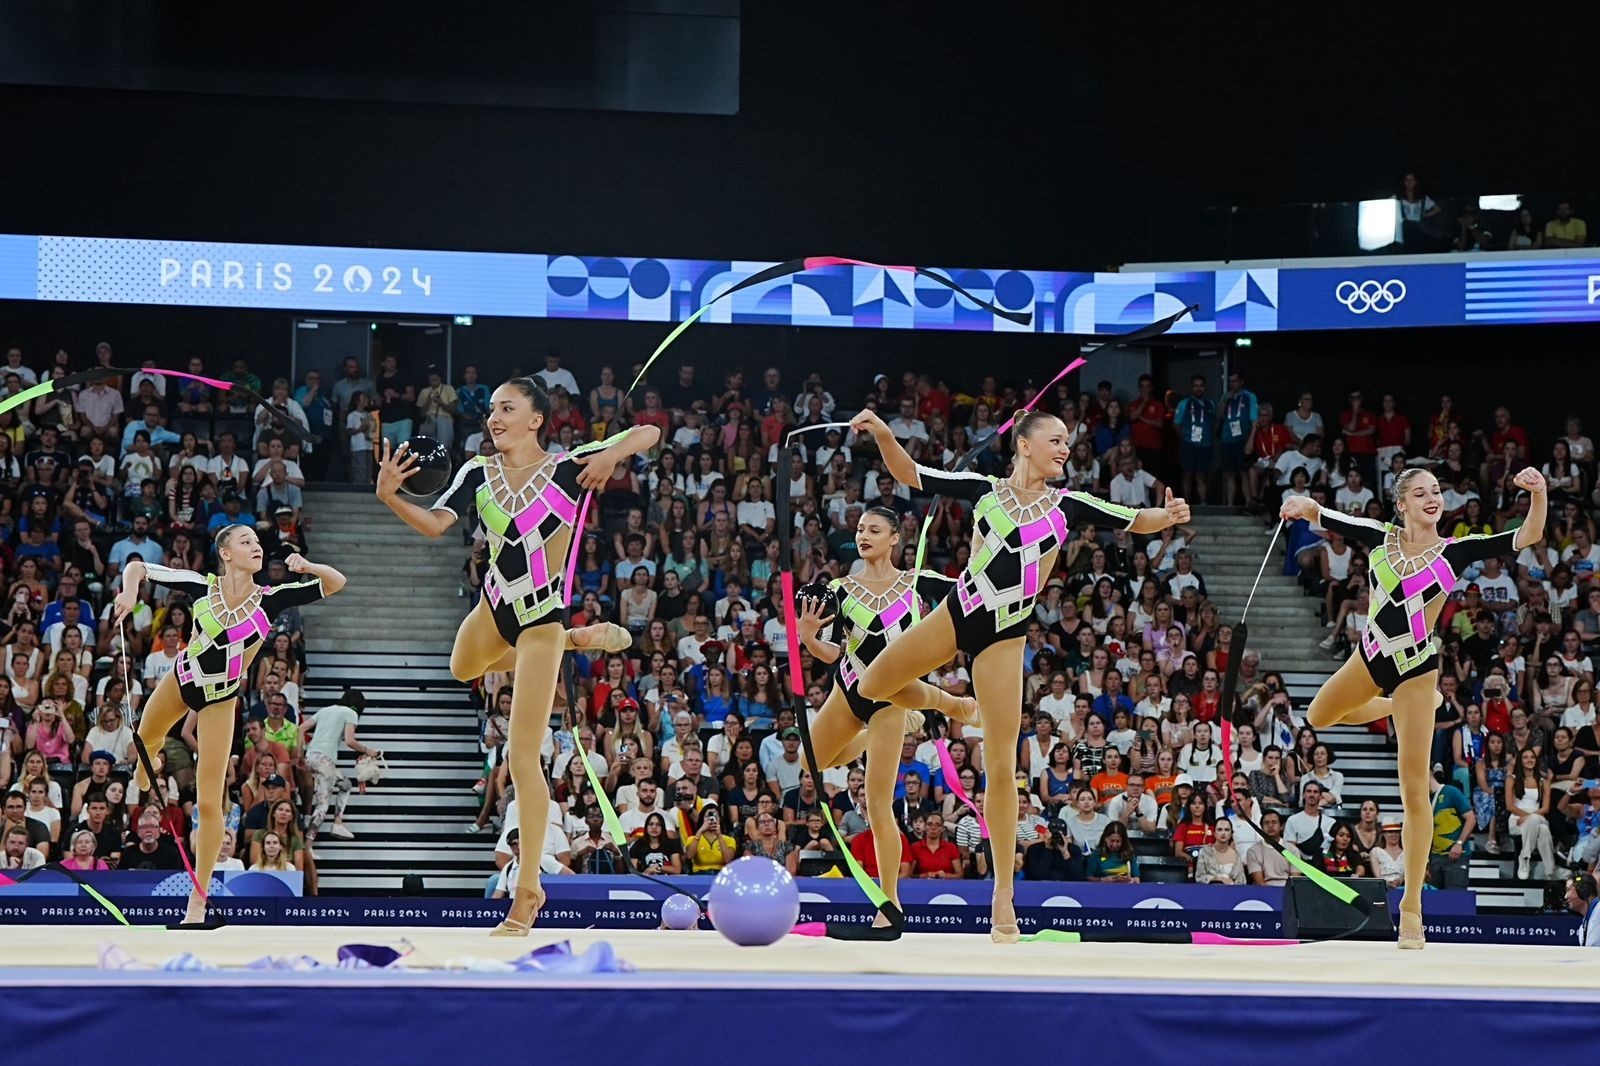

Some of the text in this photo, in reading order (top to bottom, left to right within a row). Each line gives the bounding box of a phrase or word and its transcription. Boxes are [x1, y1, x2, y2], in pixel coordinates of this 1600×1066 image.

[313, 263, 432, 296] 2024
[78, 908, 107, 916] 2024
[237, 908, 266, 916] 2024
[320, 909, 350, 917] 2024
[399, 909, 428, 918] 2024
[476, 910, 505, 918] 2024
[553, 911, 581, 919] 2024
[629, 911, 657, 919] 2024
[800, 914, 813, 922] 24
[860, 915, 874, 923] 20
[934, 916, 962, 924] 2024
[1016, 917, 1037, 925] 024
[1086, 919, 1114, 927] 2024
[1160, 920, 1188, 928] 2024
[1234, 922, 1262, 930] 2024
[1455, 926, 1482, 934] 2024
[1528, 928, 1556, 936] 2024
